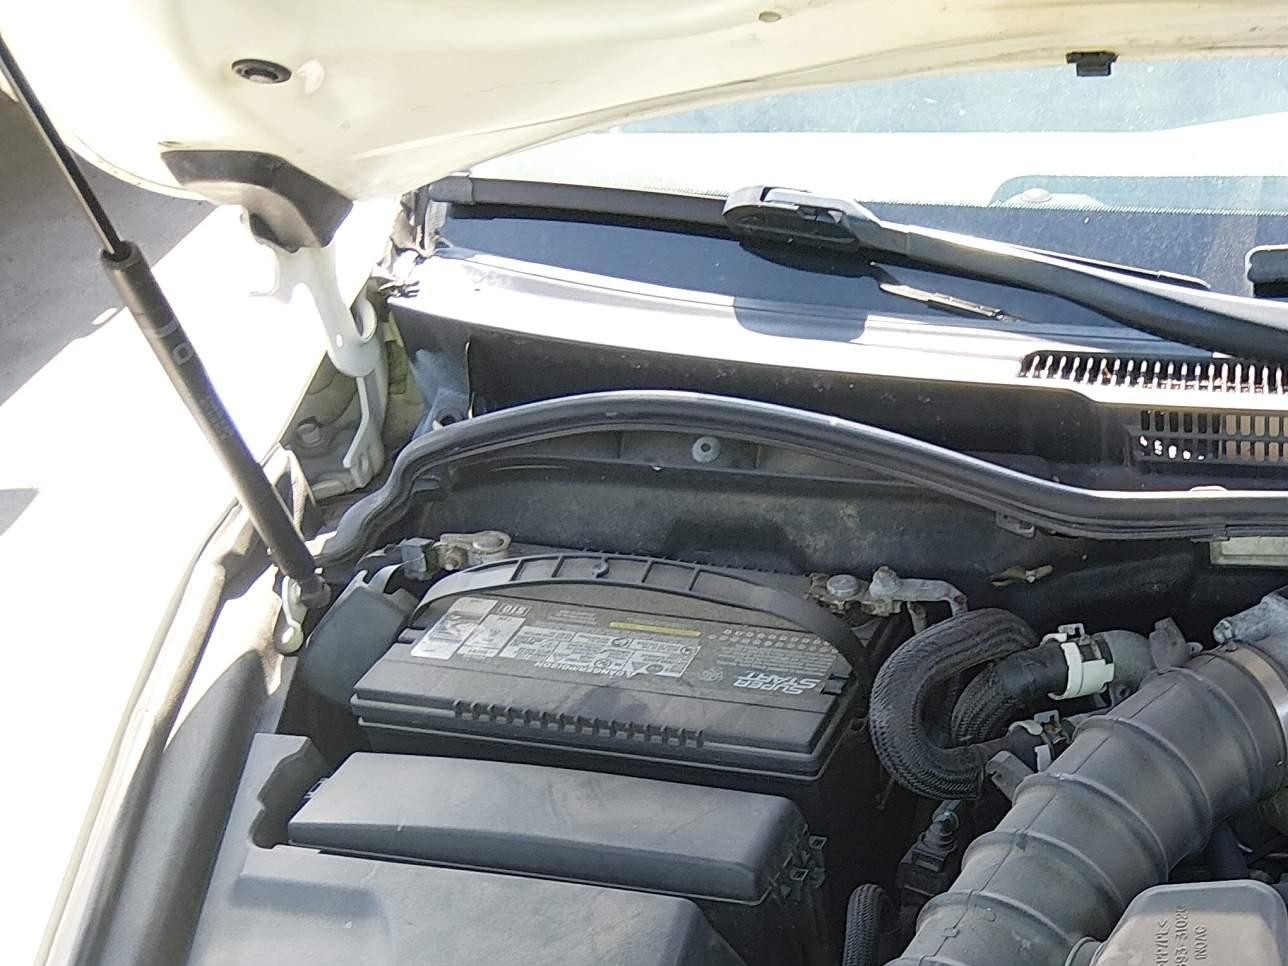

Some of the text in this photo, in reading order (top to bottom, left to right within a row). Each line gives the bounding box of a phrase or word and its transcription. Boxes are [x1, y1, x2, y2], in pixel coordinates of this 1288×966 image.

[733, 680, 803, 695] SUPER
[736, 670, 821, 689] START
[1193, 924, 1208, 960] INOAC
